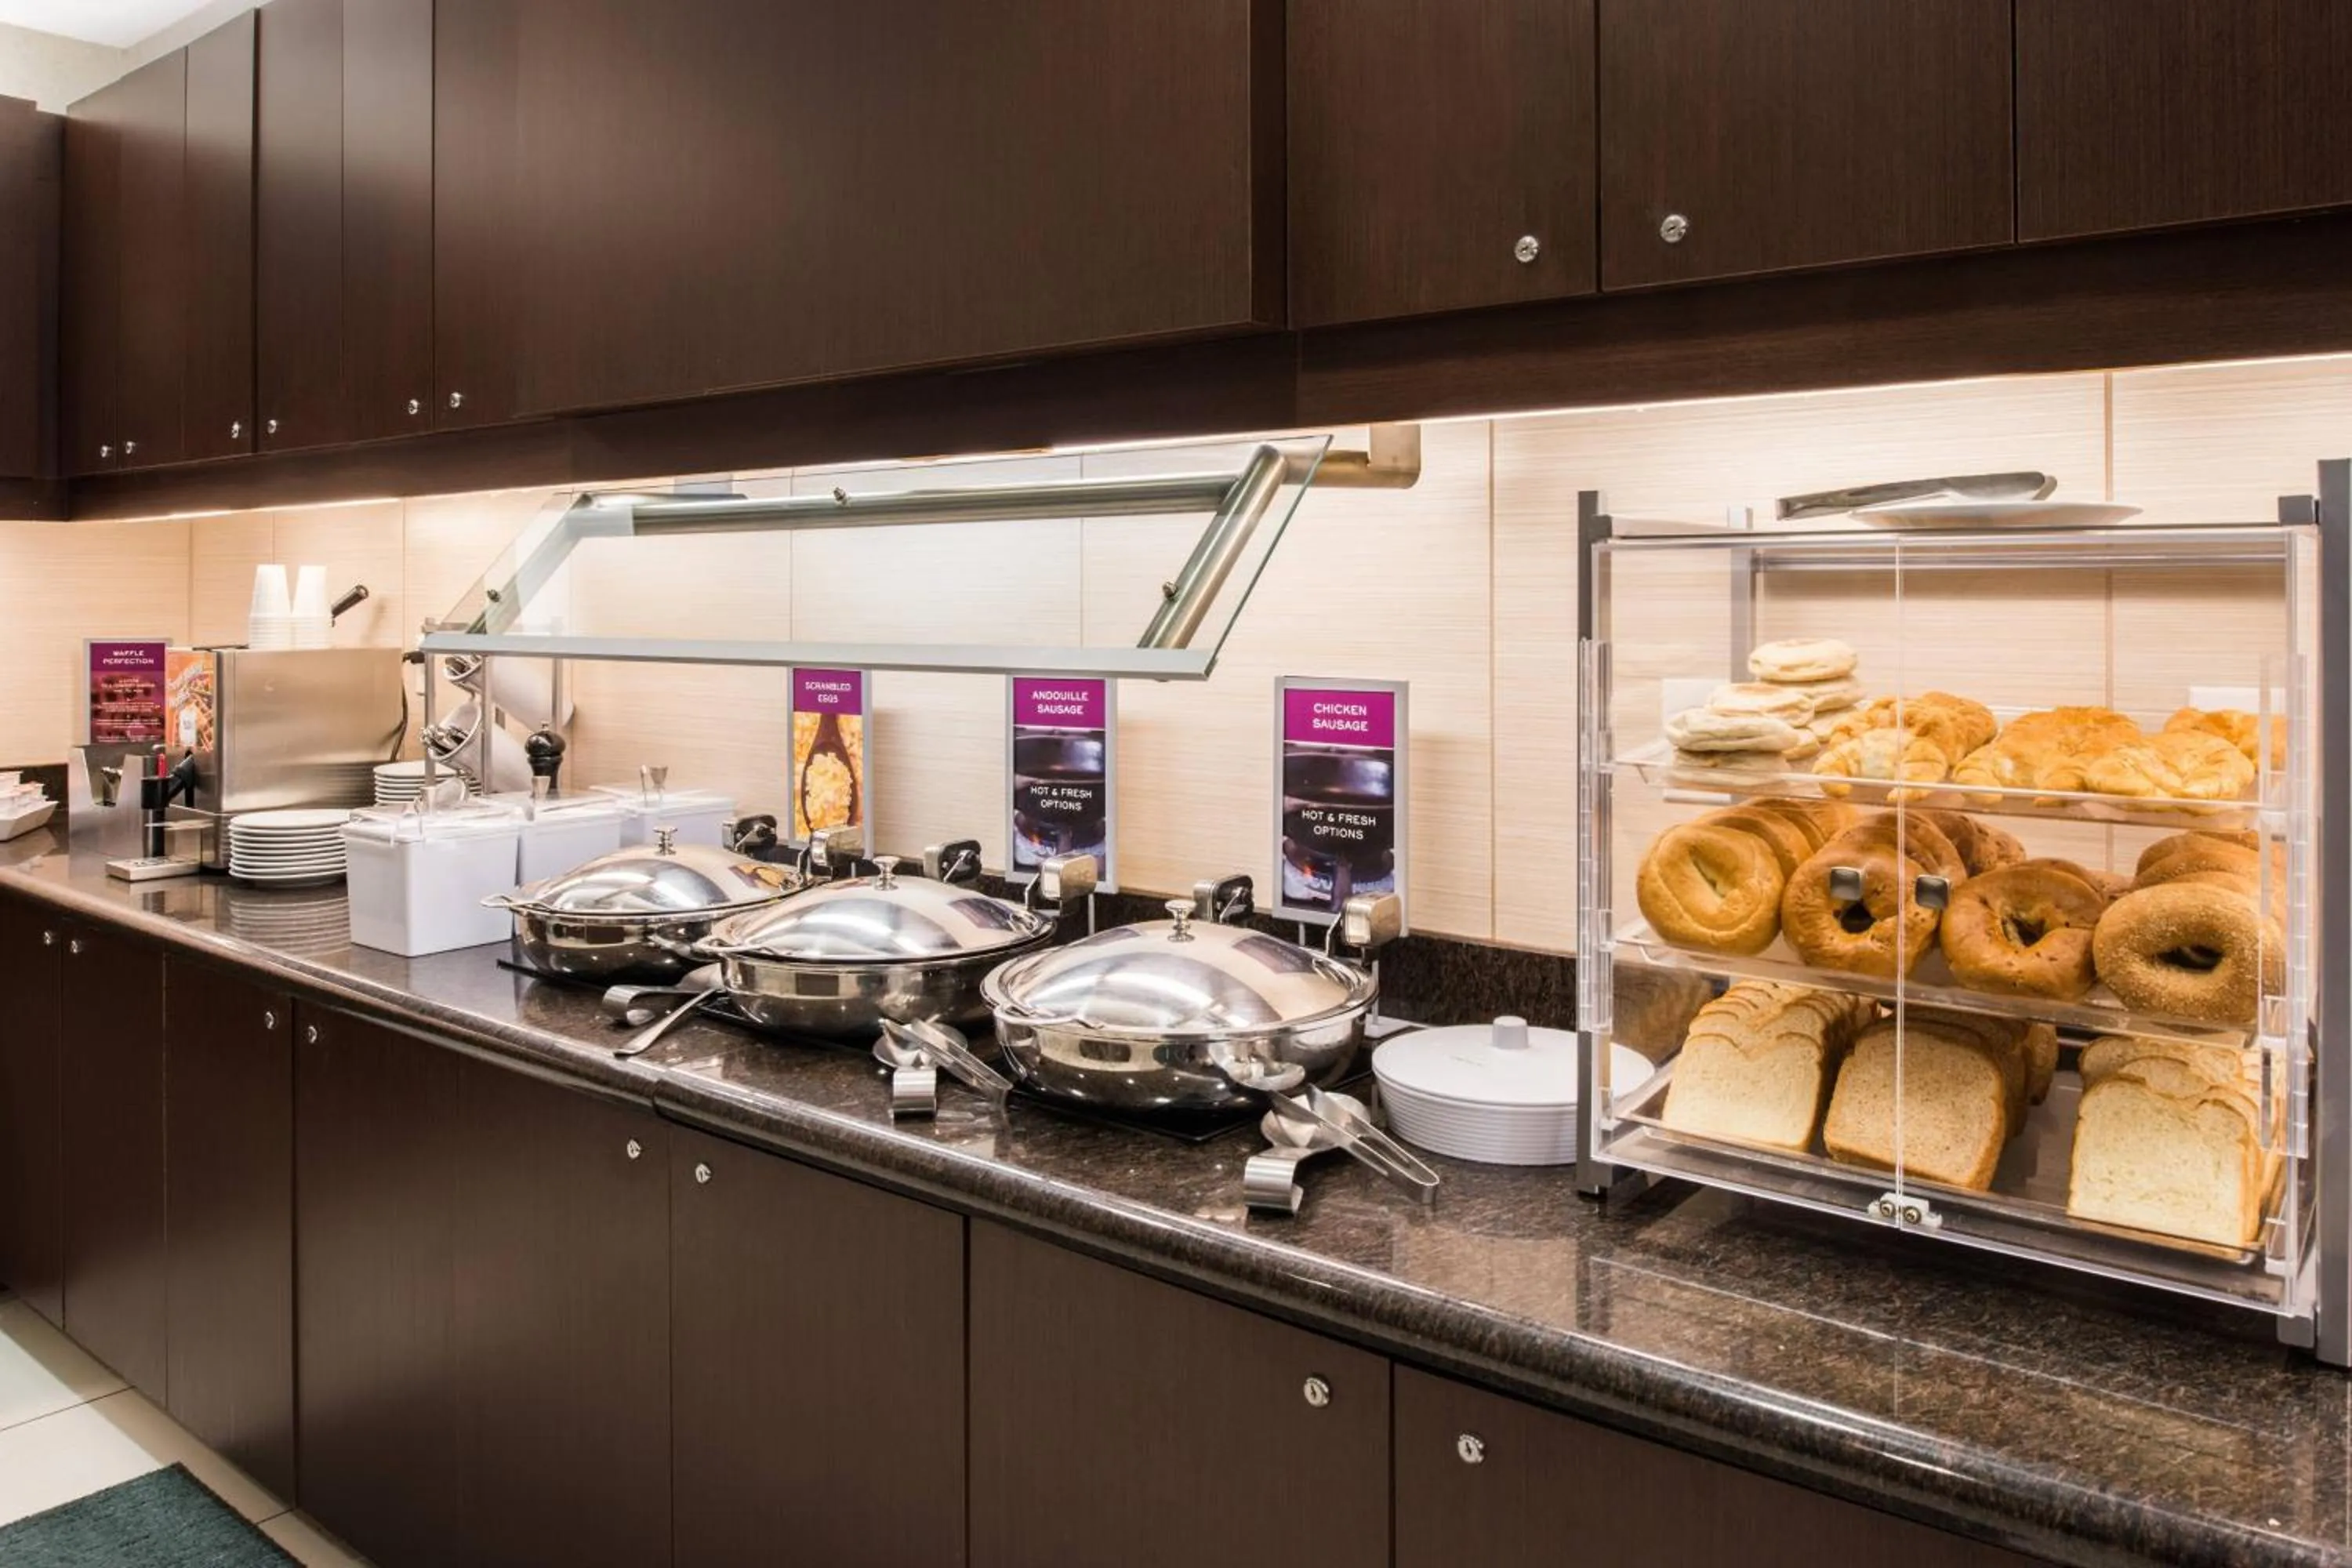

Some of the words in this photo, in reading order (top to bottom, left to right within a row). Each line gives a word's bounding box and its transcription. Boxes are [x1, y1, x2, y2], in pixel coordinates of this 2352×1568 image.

[1032, 690, 1089, 702] ANDOUILLE
[1036, 704, 1083, 715] SAUSAGE
[1313, 702, 1367, 716] CHICKEN
[1312, 718, 1368, 731] SAUSAGE
[1030, 786, 1049, 796] HOT
[1051, 787, 1058, 796] &
[1061, 789, 1092, 798] FRESH
[1040, 800, 1083, 811] OPTIONS
[1301, 811, 1324, 822] HOT
[1327, 811, 1335, 822] &
[1338, 814, 1377, 826] FRESH
[1313, 826, 1364, 839] OPTIONS
